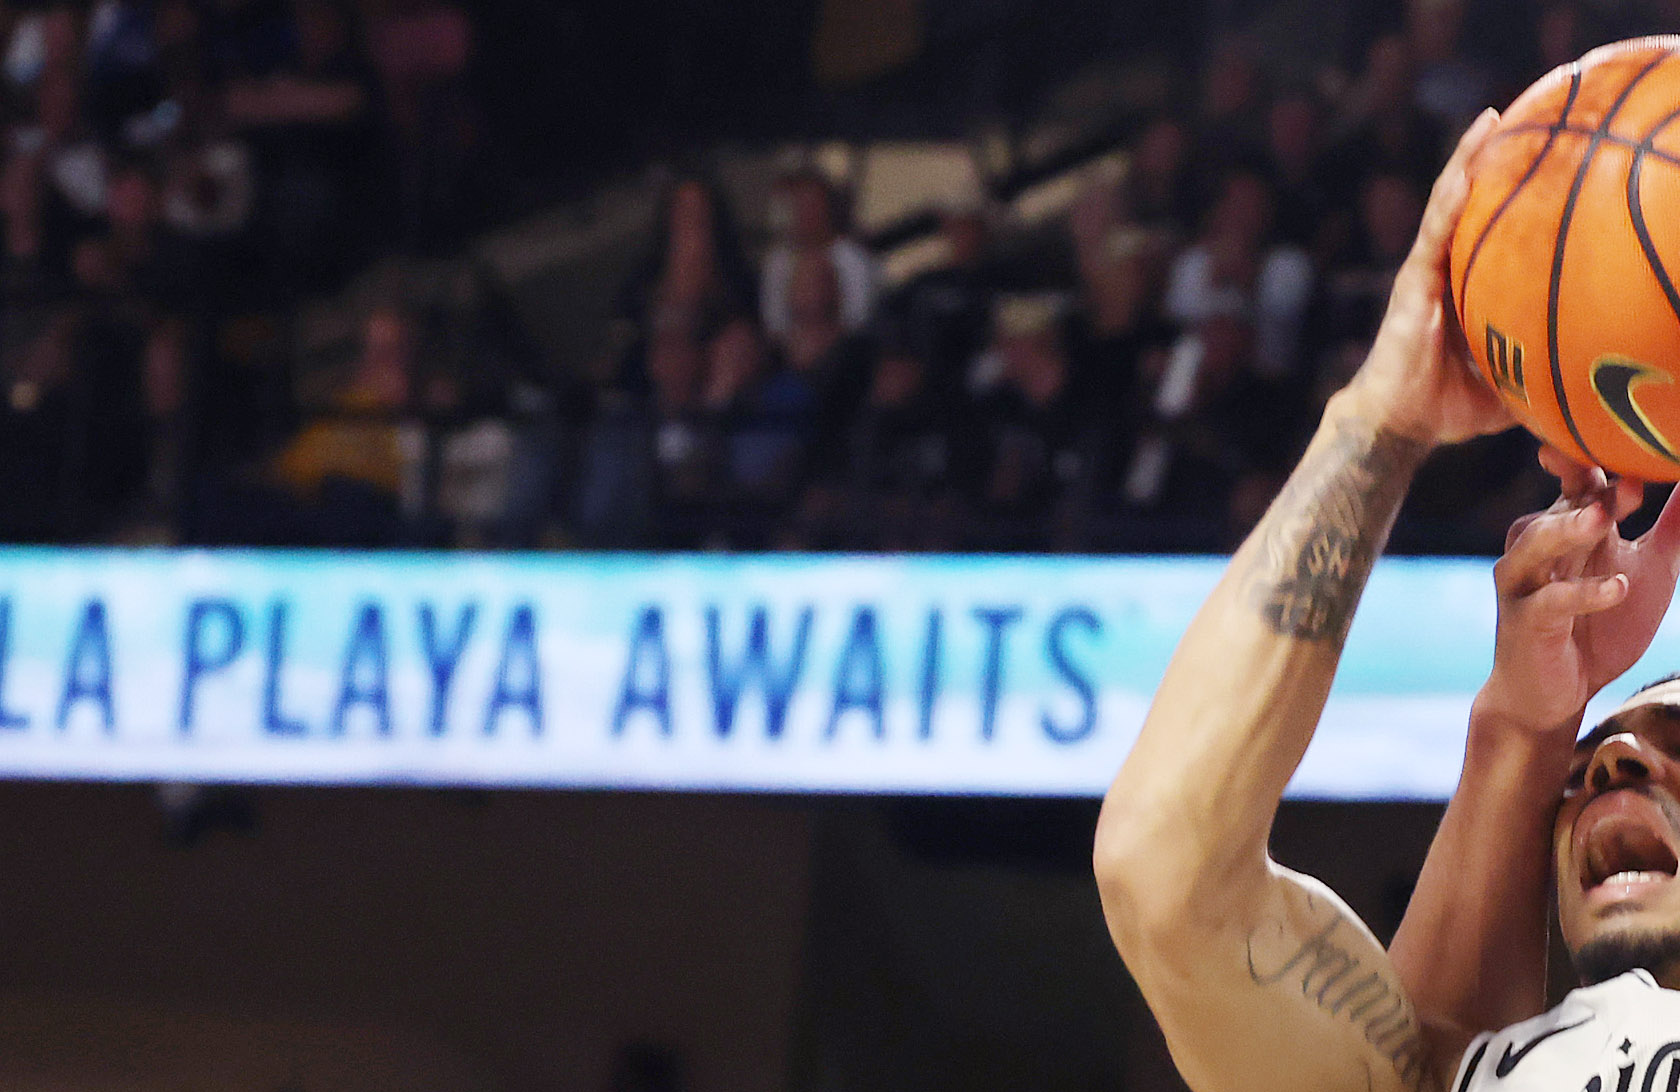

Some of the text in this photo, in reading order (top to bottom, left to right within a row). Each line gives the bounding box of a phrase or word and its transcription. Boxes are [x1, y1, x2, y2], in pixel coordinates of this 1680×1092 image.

[0, 596, 1103, 745] LA PLAYA AWAITS
